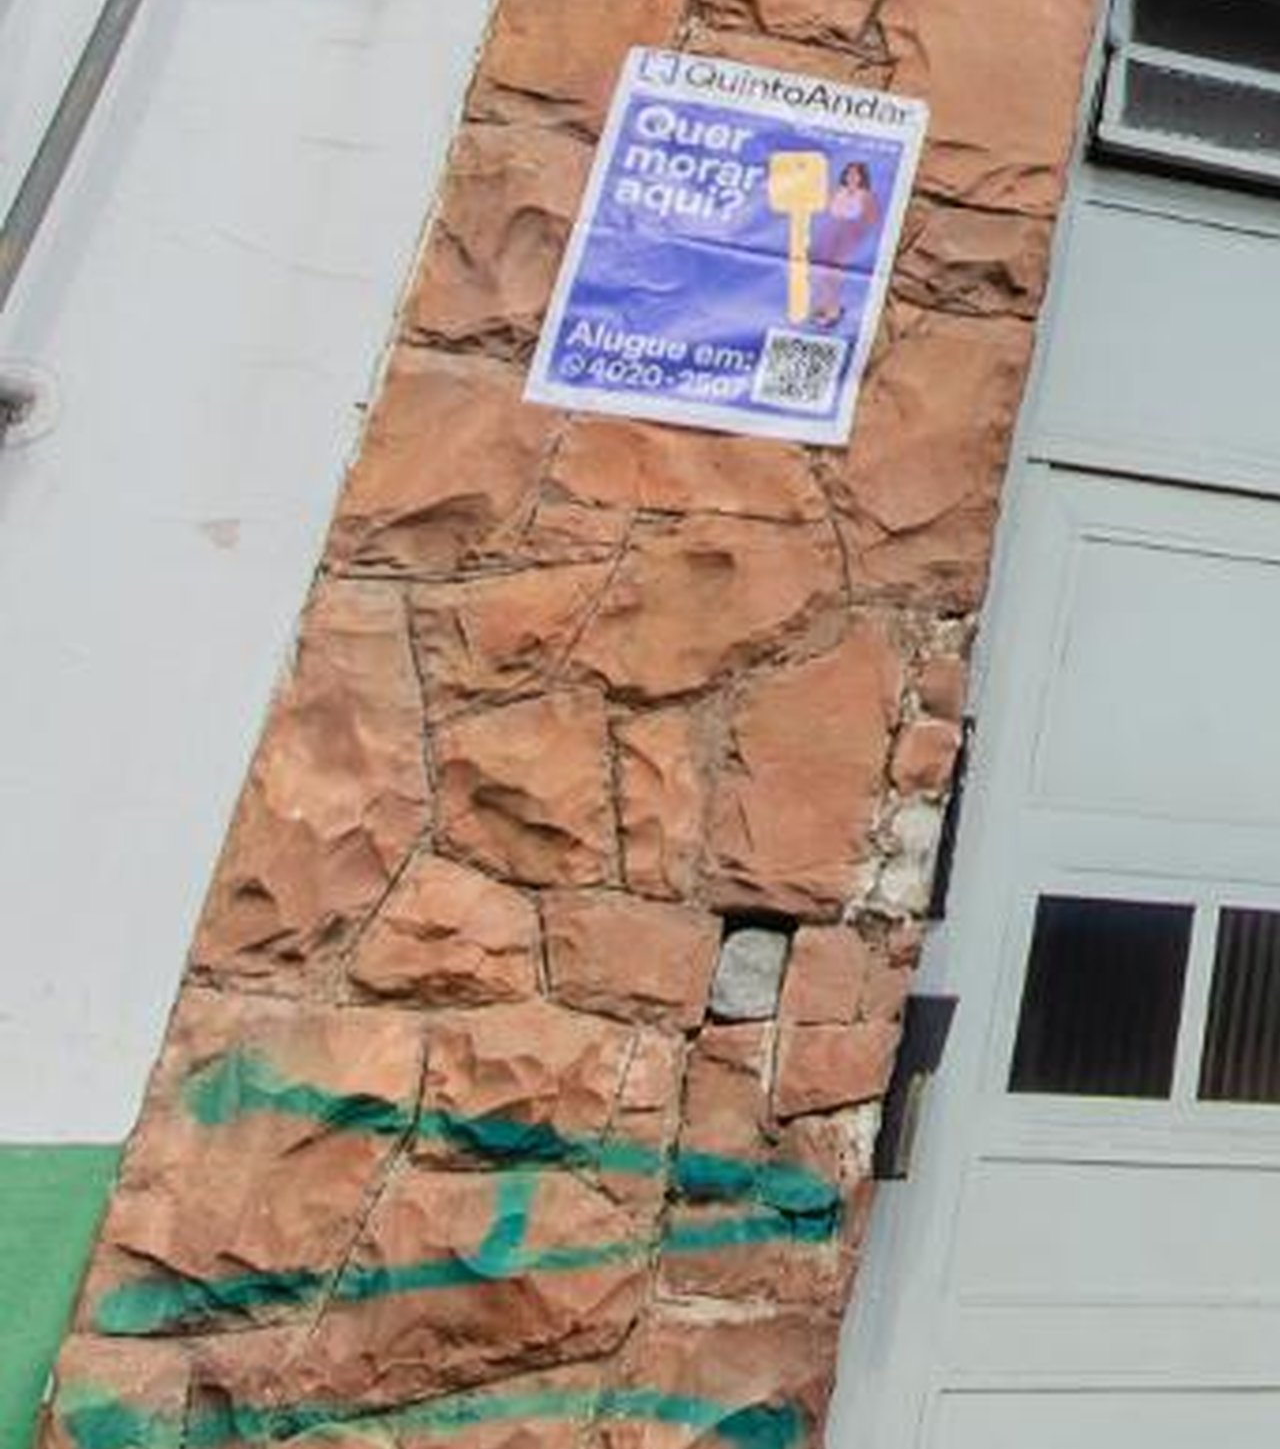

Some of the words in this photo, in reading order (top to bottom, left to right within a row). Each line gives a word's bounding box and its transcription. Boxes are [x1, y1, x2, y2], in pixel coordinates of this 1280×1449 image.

[685, 62, 906, 125] QuintoAndar
[637, 106, 755, 152] Quer
[624, 146, 765, 191] morar
[614, 177, 745, 222] aqui?
[567, 320, 688, 362] Alugue
[694, 344, 755, 371] em:
